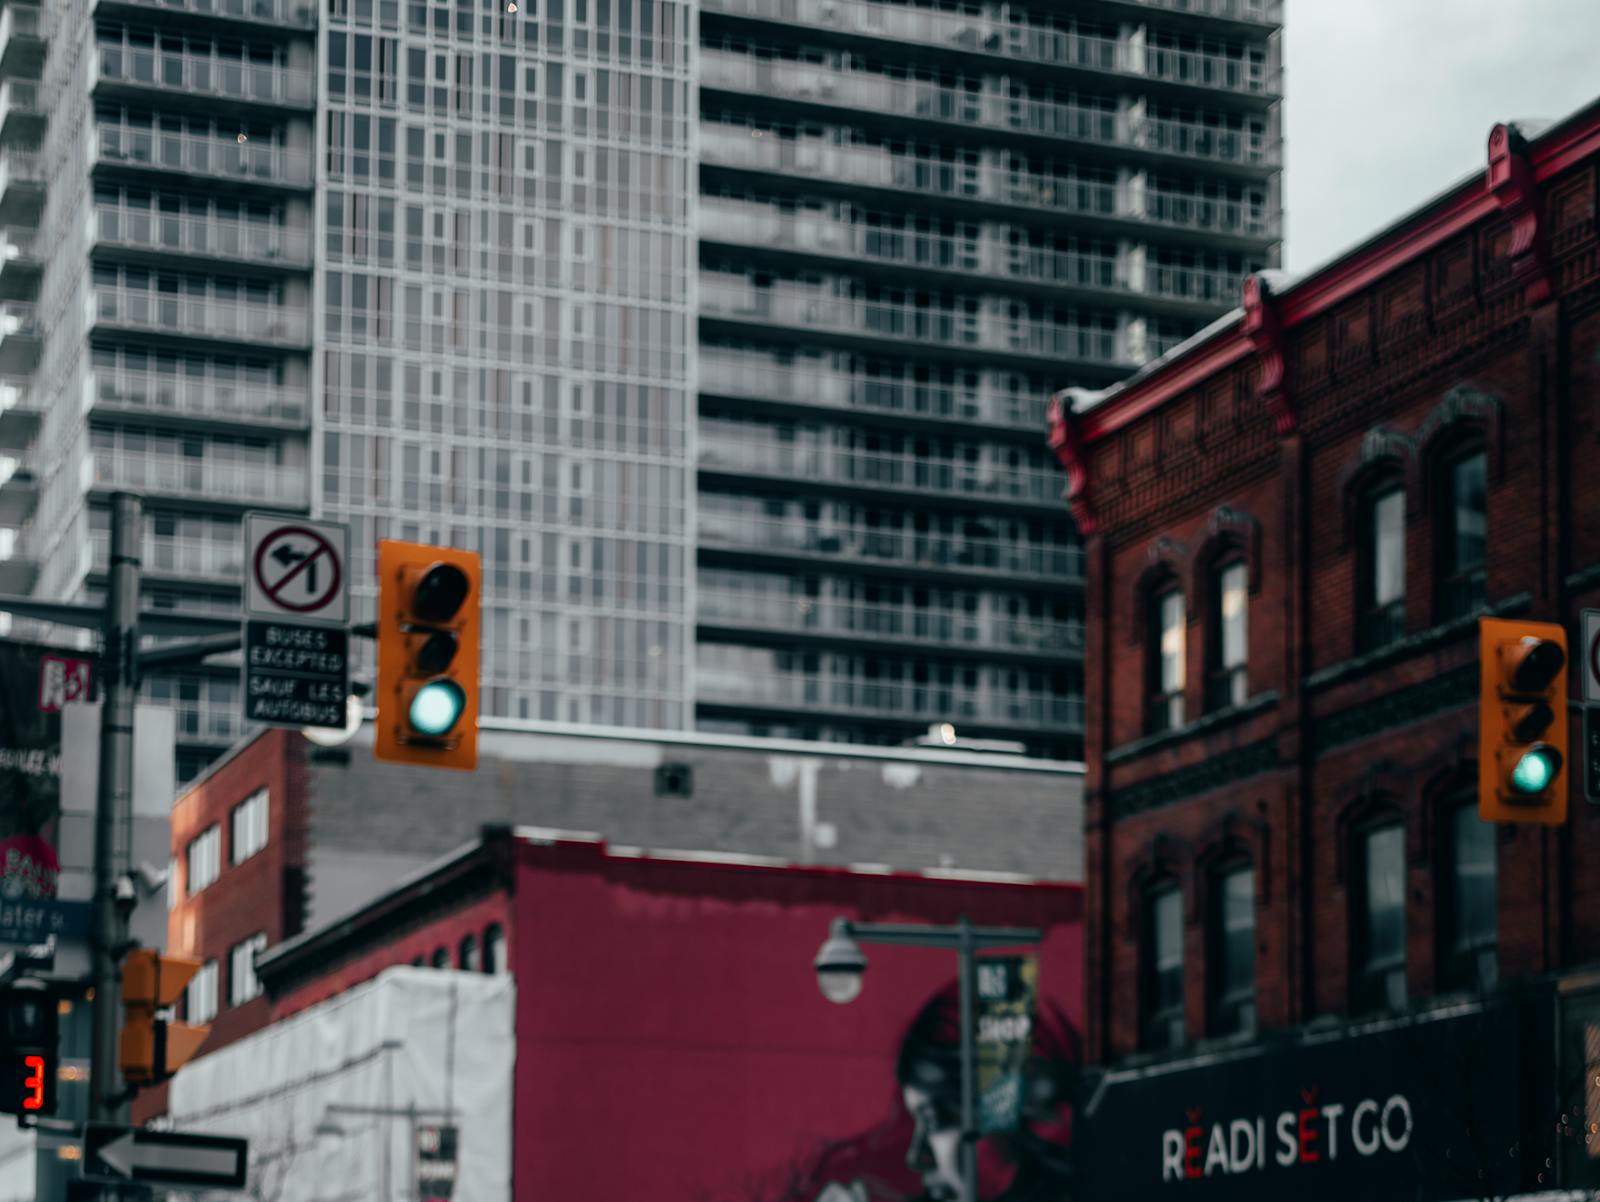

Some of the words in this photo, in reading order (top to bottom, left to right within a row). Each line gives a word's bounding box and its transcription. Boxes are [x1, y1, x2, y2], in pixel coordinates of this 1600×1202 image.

[266, 626, 329, 650] BUSES
[250, 645, 344, 673] EXCEPTED
[249, 675, 298, 698] SAUF
[308, 682, 344, 704] LES
[254, 698, 341, 724] AUTOBUS
[23, 1055, 45, 1110] 3
[1351, 1093, 1414, 1157] GO
